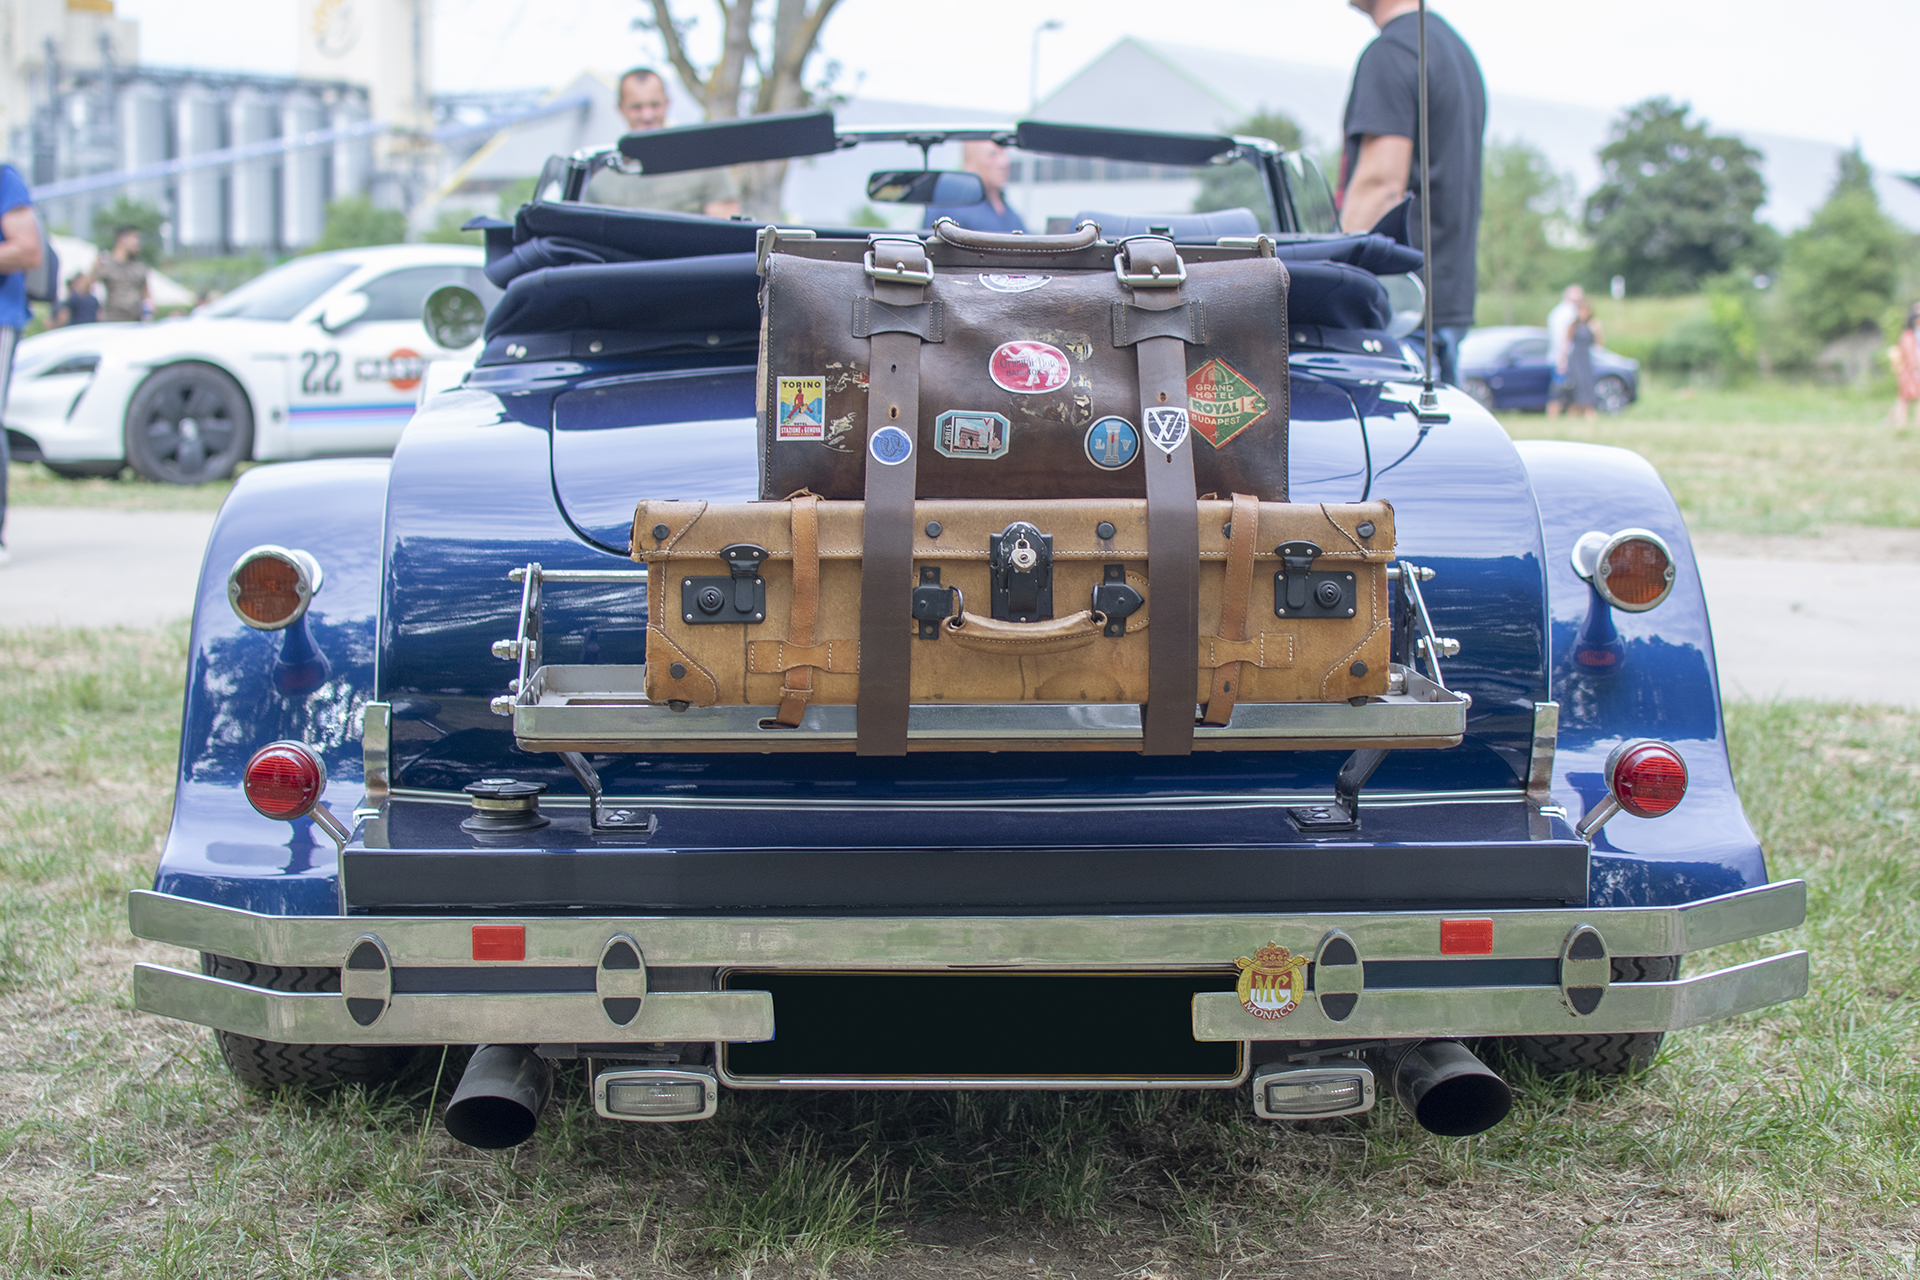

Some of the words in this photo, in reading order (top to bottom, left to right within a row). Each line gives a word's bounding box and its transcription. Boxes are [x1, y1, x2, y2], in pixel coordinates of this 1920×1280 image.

[301, 350, 341, 393] 22
[1006, 369, 1041, 377] BANGKOK
[1195, 383, 1234, 392] GRAND
[1195, 391, 1234, 400] HOTEL
[1191, 399, 1240, 415] ROYAL
[1191, 413, 1241, 426] BUDAPEST
[944, 424, 952, 445] PARIS
[1094, 438, 1106, 450] L
[1120, 439, 1132, 451] V
[1253, 975, 1290, 1003] MC
[1244, 1001, 1296, 1019] MONACO
